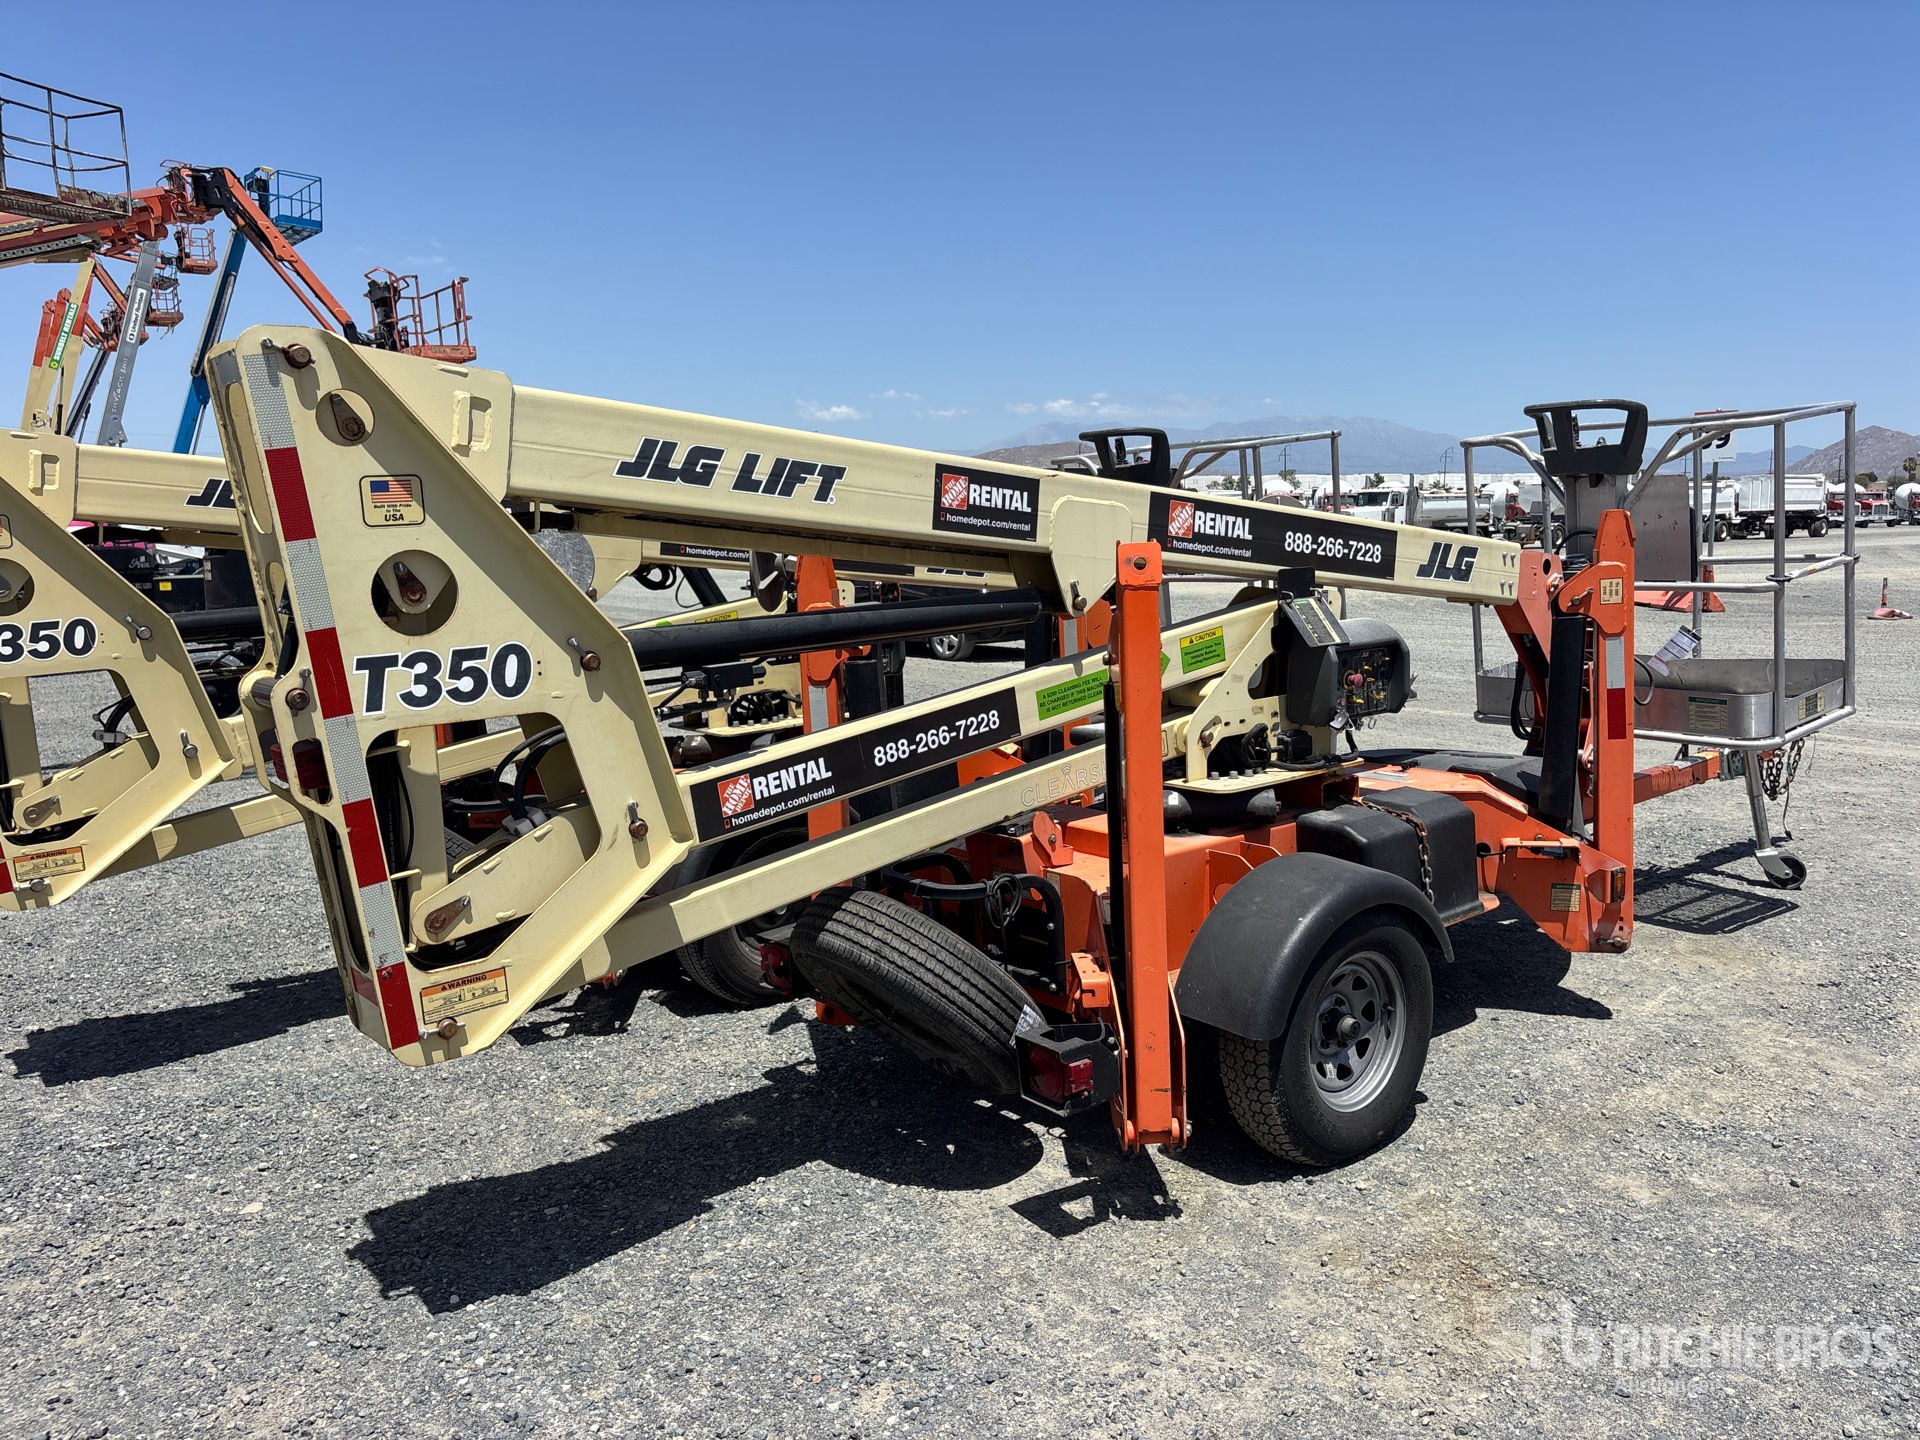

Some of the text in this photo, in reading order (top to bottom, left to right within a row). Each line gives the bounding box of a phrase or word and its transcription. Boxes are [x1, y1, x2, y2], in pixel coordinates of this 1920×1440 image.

[131, 292, 145, 333] United Rentals
[53, 303, 78, 361] SUNBELT RENTALS
[612, 435, 849, 504] JLG LIFT
[942, 476, 968, 508] HOME
[951, 490, 968, 508] DEPOT
[968, 483, 1032, 513] RENTAL
[384, 513, 405, 522] USA
[946, 512, 1031, 532] homedepot.com/rental
[1169, 503, 1194, 536] HOME
[1178, 516, 1193, 537] DEPOT
[1194, 510, 1253, 541] RENTAL
[1172, 539, 1252, 558] homedepot.com/rental
[1284, 531, 1382, 564] 888-266-7228
[1415, 541, 1480, 583] JLG
[1194, 631, 1217, 642] CAUTION
[353, 641, 533, 716] T350
[1046, 690, 1058, 699] $200
[1057, 682, 1082, 694] CLEANING
[1081, 678, 1091, 686] FEE
[1091, 675, 1103, 683] WILL
[1046, 694, 1070, 706] CHARGED
[1051, 703, 1061, 712] NOT
[1061, 695, 1087, 707] RETURNED
[873, 709, 1001, 767] 888-266-7228
[722, 782, 736, 799] THE
[752, 756, 832, 800] RENTAL
[721, 776, 750, 816] HOME
[731, 784, 836, 827] homedepot.com/rental
[735, 787, 752, 813] DEPOT
[35, 850, 68, 860] WARNING
[448, 974, 488, 989] WARNING
